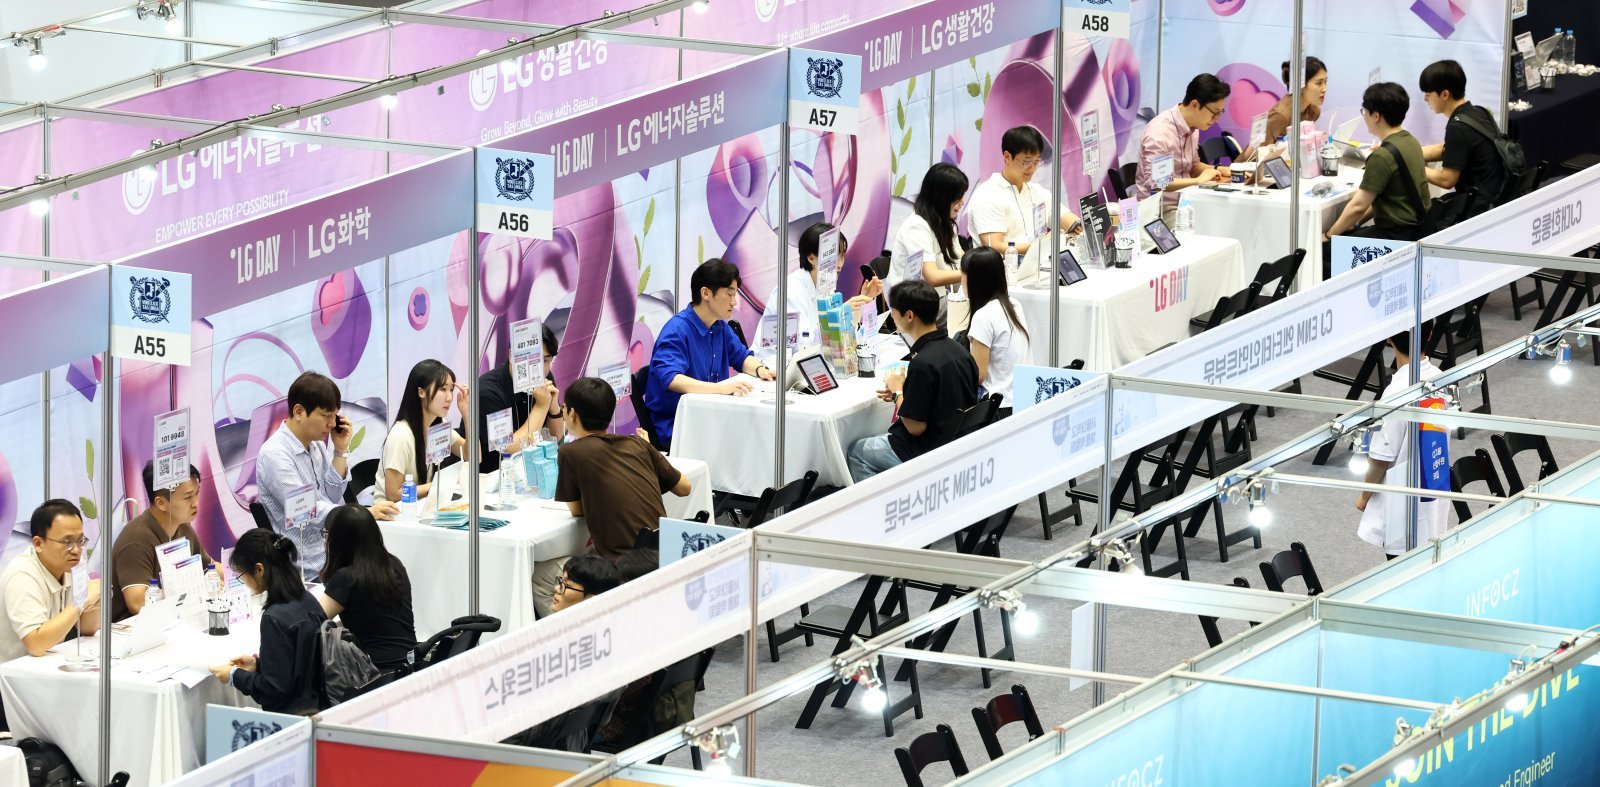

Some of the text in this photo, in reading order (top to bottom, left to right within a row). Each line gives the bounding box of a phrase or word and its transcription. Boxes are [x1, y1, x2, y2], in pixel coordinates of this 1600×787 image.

[1082, 14, 1110, 33] A58
[868, 31, 903, 74] LG DAY
[480, 124, 502, 142] Grow
[533, 109, 553, 128] Glow
[572, 95, 599, 116] Beauty
[616, 91, 725, 157] LG에너지솔루션
[808, 108, 837, 127] A57
[555, 133, 595, 179] LG DAY
[155, 188, 290, 244] EMPOWER EVERY POSSIBILITY
[308, 207, 372, 260] LG화학
[497, 212, 530, 233] A56
[236, 235, 281, 284] LG DAY
[1153, 265, 1190, 313] LG DAY
[133, 335, 167, 358] A55
[1465, 567, 1520, 617] INFOCZ
[1514, 751, 1556, 787] Engineer
